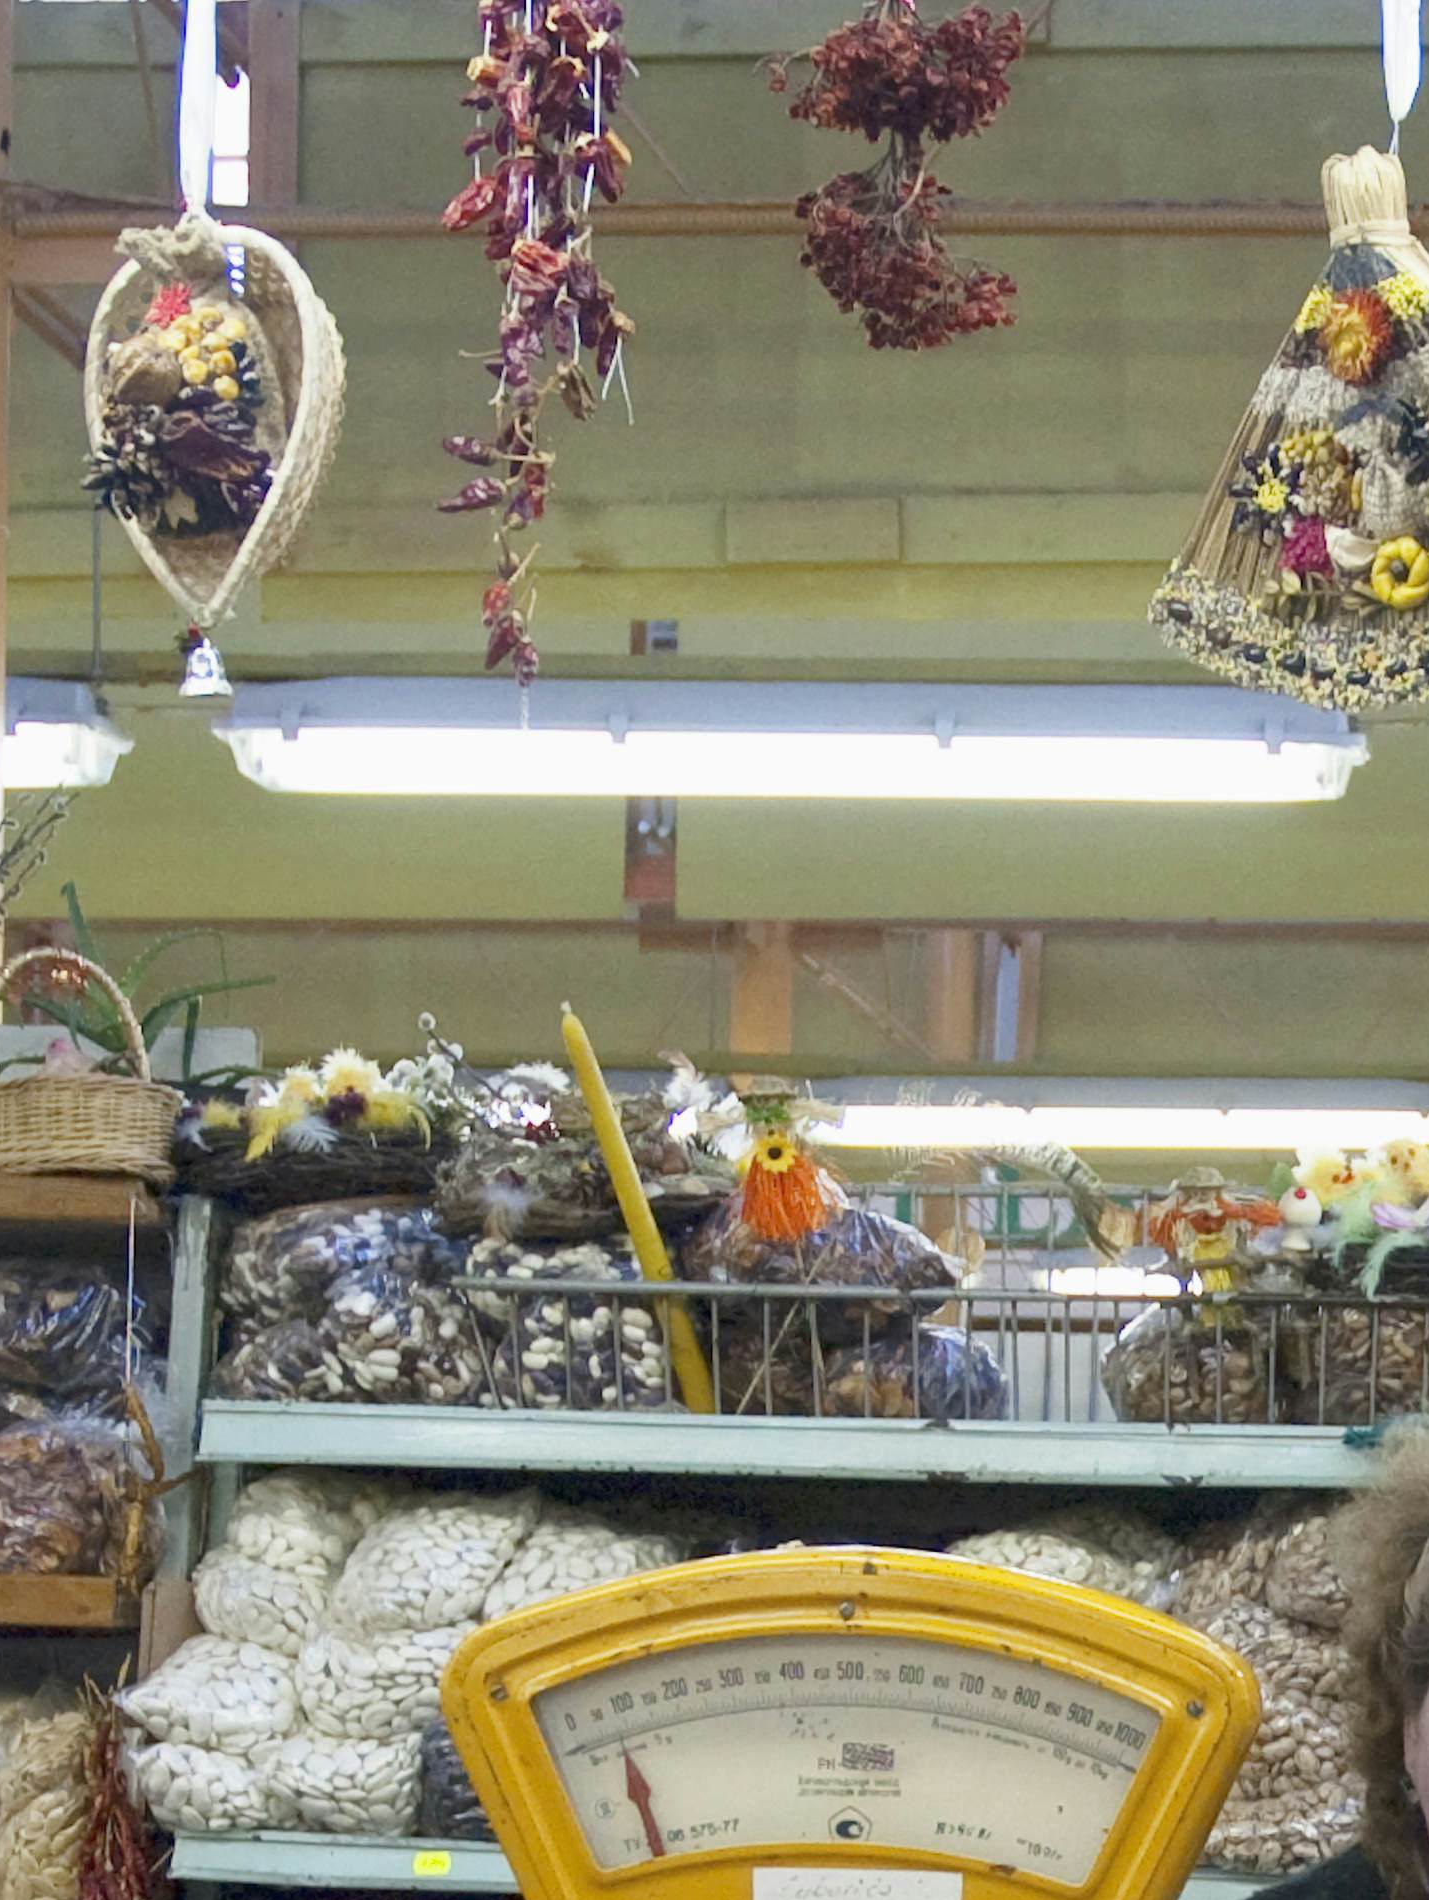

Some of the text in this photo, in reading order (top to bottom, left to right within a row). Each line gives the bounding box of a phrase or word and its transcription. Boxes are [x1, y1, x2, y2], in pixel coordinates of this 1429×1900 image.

[563, 1712, 577, 1732] 0
[609, 1692, 635, 1714] 100
[661, 1677, 689, 1701] 200
[719, 1667, 745, 1688] 300
[779, 1661, 805, 1681] 400
[836, 1661, 864, 1681] 500
[899, 1664, 925, 1685] 600
[959, 1672, 985, 1695] 700
[1013, 1686, 1041, 1710] 800
[1066, 1702, 1094, 1729] 900
[1114, 1721, 1147, 1751] 1000
